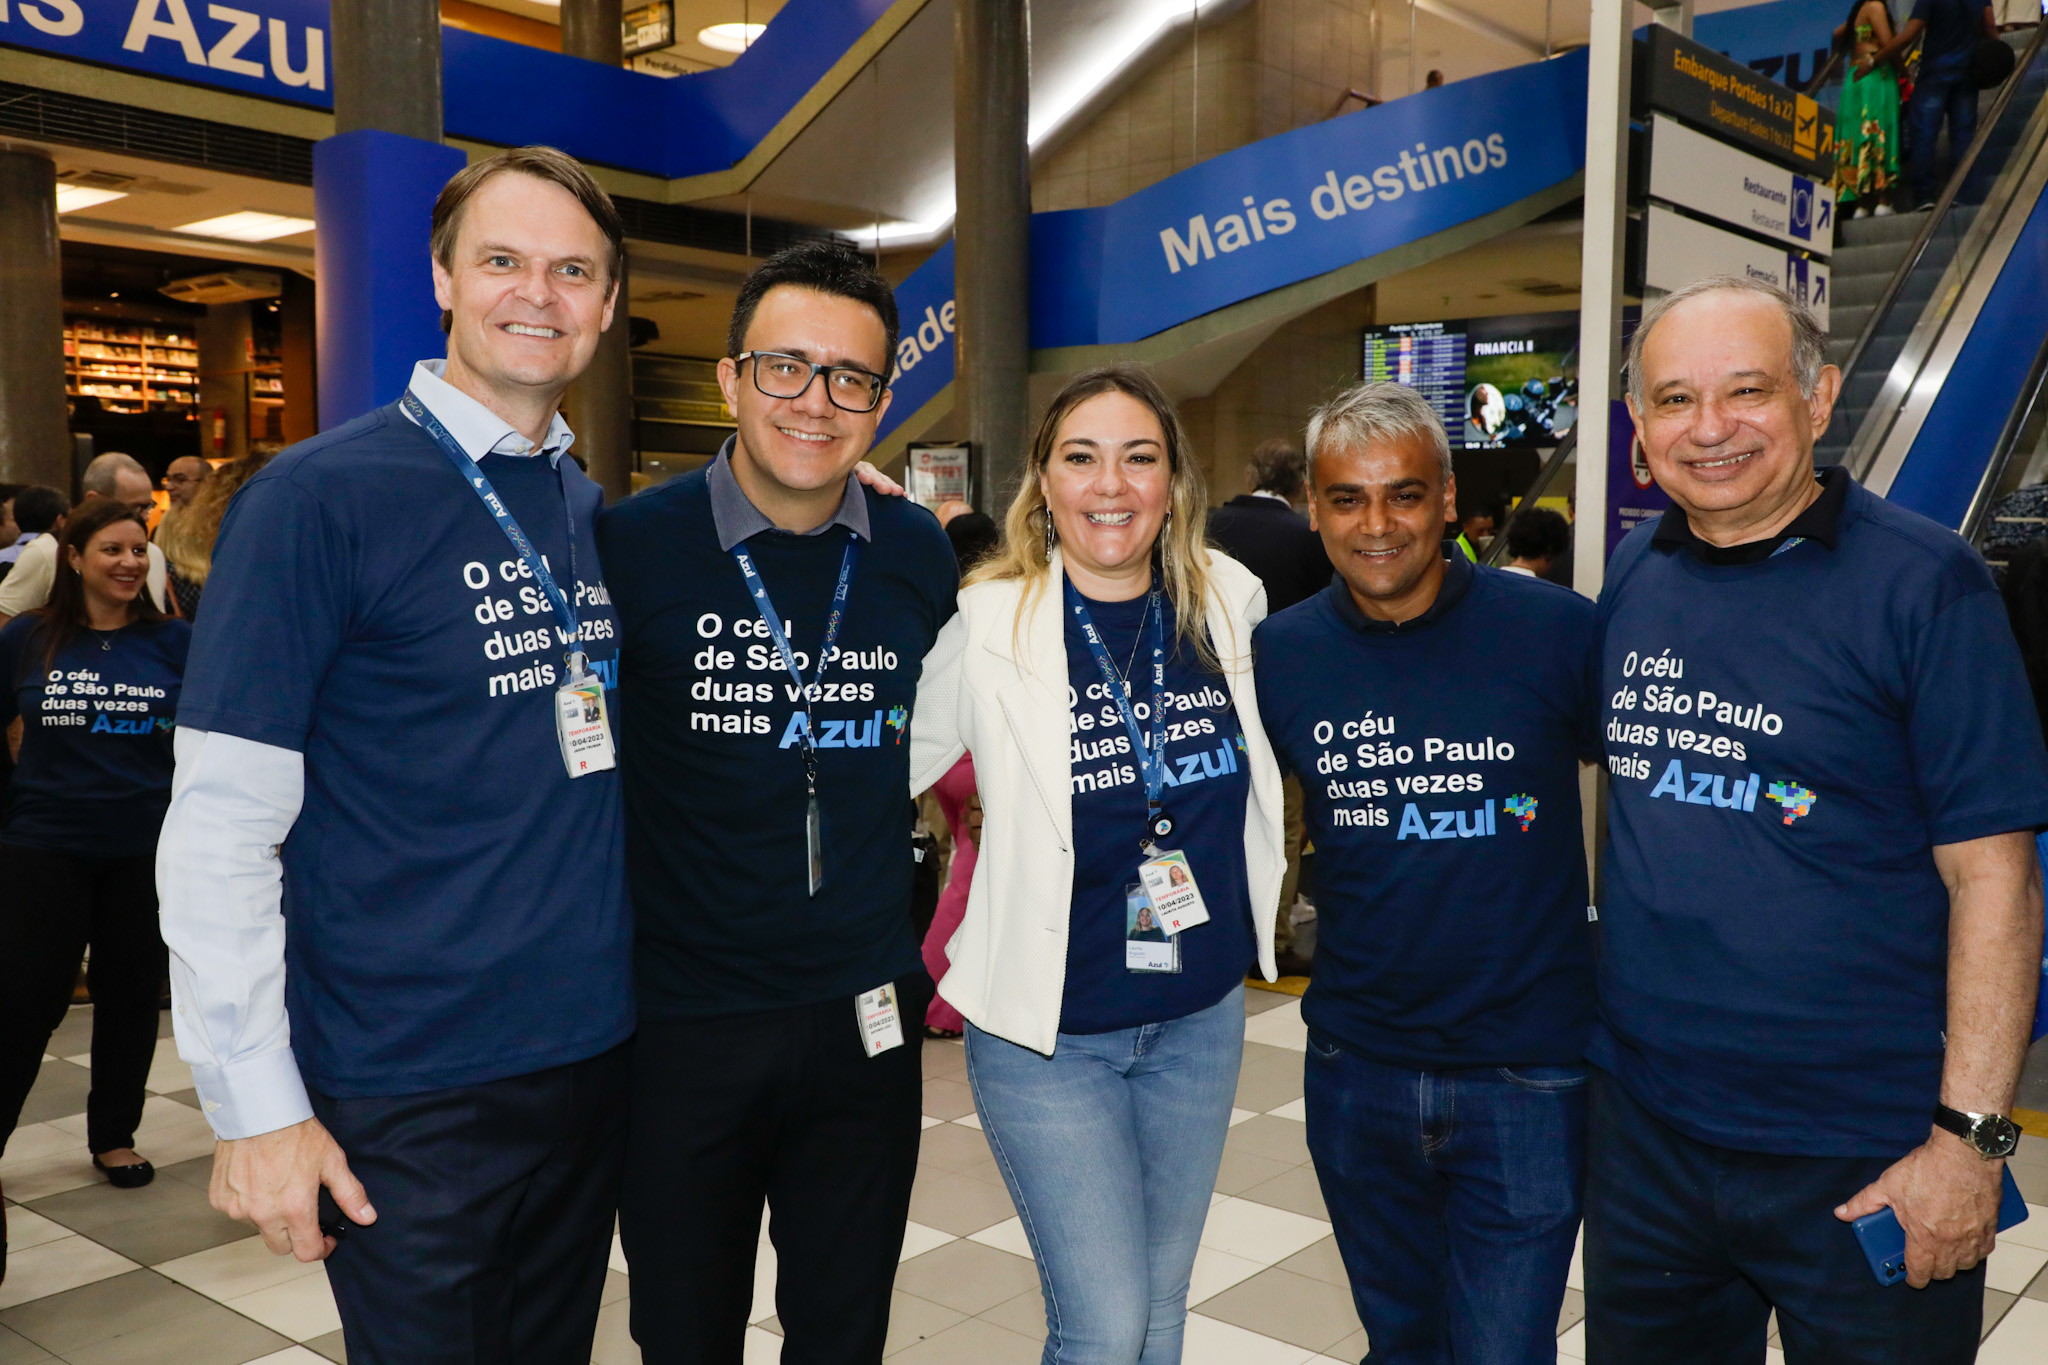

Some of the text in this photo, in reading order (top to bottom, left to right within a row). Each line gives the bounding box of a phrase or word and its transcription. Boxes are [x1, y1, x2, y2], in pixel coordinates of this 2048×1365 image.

[1673, 49, 1729, 91] Embarque
[1730, 75, 1767, 109] Portões
[1783, 102, 1793, 121] 22
[1711, 100, 1747, 131] Departure
[1750, 117, 1768, 141] Gates
[1160, 133, 1507, 274] Mais destinos
[1744, 177, 1787, 205] Restaurante
[1752, 209, 1785, 233] Restaurant
[1474, 341, 1524, 356] FINANCIA
[484, 492, 507, 517] Azul
[463, 562, 490, 589] O
[737, 555, 756, 578] Azul
[475, 596, 514, 624] de
[697, 613, 723, 638] O
[1082, 623, 1100, 644] Azul
[484, 627, 551, 660] duas
[694, 645, 898, 671] de São Paulo
[817, 647, 829, 674] Azul
[1623, 648, 1683, 678] O céu
[48, 669, 99, 682] O céu
[489, 648, 620, 697] mais zul
[1154, 664, 1164, 686] Azul
[45, 682, 165, 698] de São Paulo
[691, 677, 875, 702] duas vezes
[42, 697, 149, 712] duas vezes
[1100, 702, 1150, 728] So
[1612, 685, 1783, 736] de São Paulo
[42, 713, 155, 734] mais Azul
[691, 710, 883, 749] mais Azul
[1314, 710, 1395, 745] O céu
[1070, 735, 1130, 764] duas
[1144, 717, 1216, 749] zes
[1607, 717, 1747, 761] duas vezes
[580, 760, 588, 770] R
[1317, 737, 1515, 774] de São Paulo
[1071, 762, 1136, 795] mais
[1327, 773, 1483, 799] duas vezes
[1609, 752, 1760, 812] mais Azul
[1334, 799, 1496, 840] mais Azul
[1158, 893, 1195, 911] 10/04/2023
[1172, 919, 1181, 928] R
[868, 1015, 894, 1030] 0/04/2023
[875, 1041, 882, 1049] R
